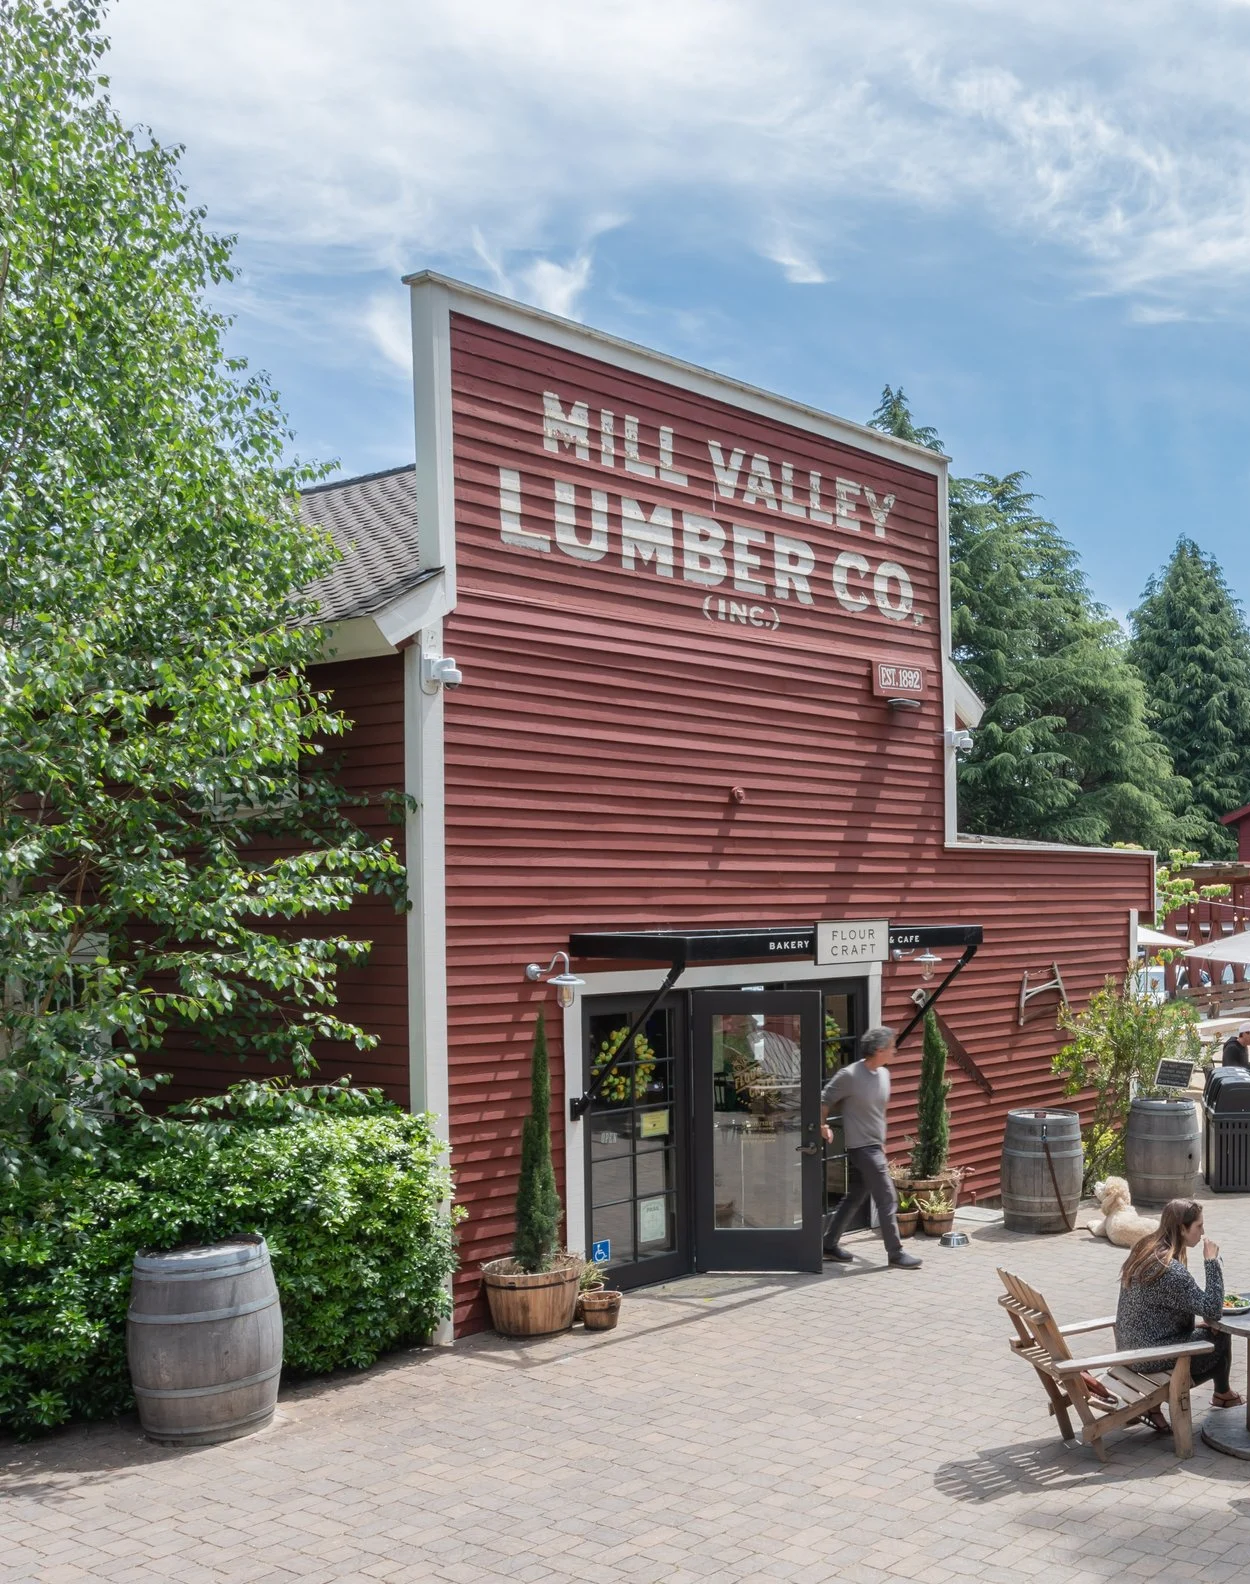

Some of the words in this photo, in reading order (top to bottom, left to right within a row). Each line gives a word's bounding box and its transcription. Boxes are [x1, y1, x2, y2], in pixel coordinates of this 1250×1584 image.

[543, 391, 688, 487] MILL
[708, 439, 896, 538] VALLEY
[499, 467, 815, 605] LUMBER
[832, 551, 925, 627] CO.
[702, 595, 781, 631] (INC.)
[769, 940, 810, 950] BAKERY
[889, 936, 895, 944] &
[897, 935, 920, 943] CAFE
[831, 928, 875, 941] FLOUR
[830, 944, 876, 956] CRAFT
